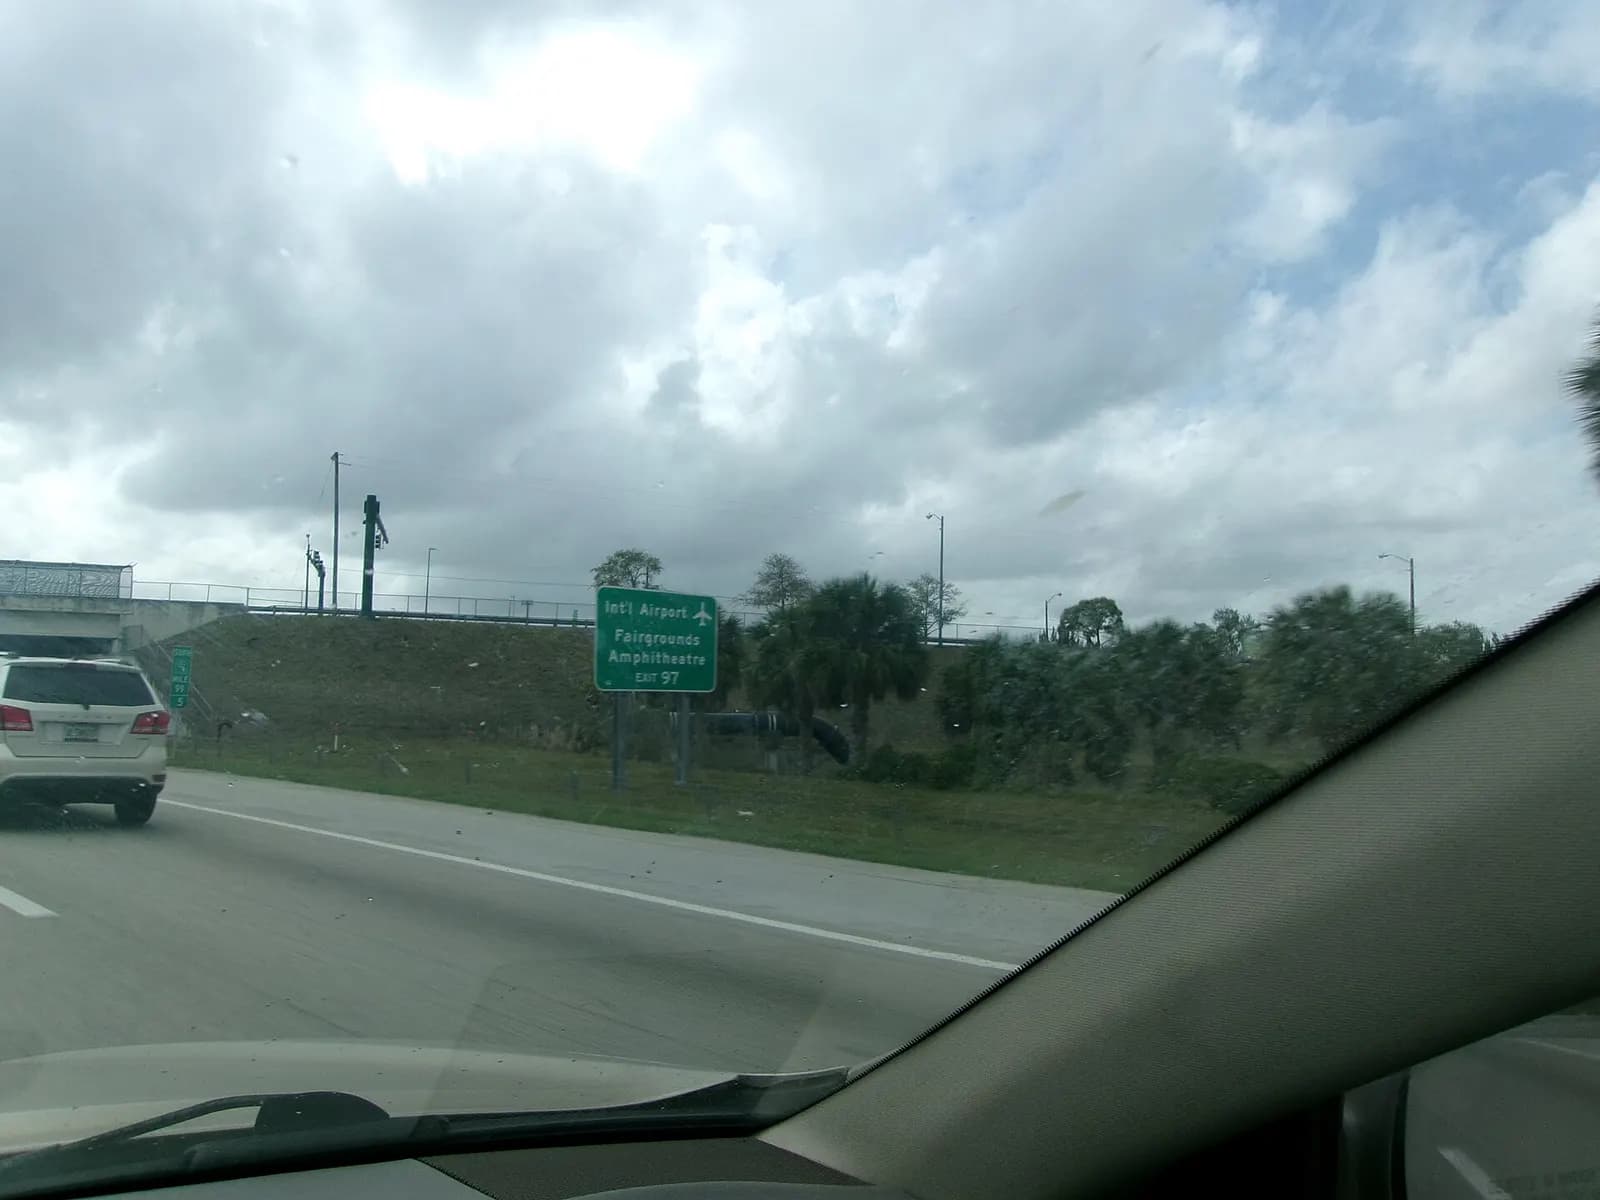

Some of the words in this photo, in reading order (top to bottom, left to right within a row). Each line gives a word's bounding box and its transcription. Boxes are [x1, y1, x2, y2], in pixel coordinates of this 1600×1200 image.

[639, 603, 688, 619] Airport
[614, 629, 701, 647] Fairgrounds
[608, 649, 706, 666] Amphitheatre
[635, 673, 658, 682] EXIT
[661, 671, 680, 685] 97
